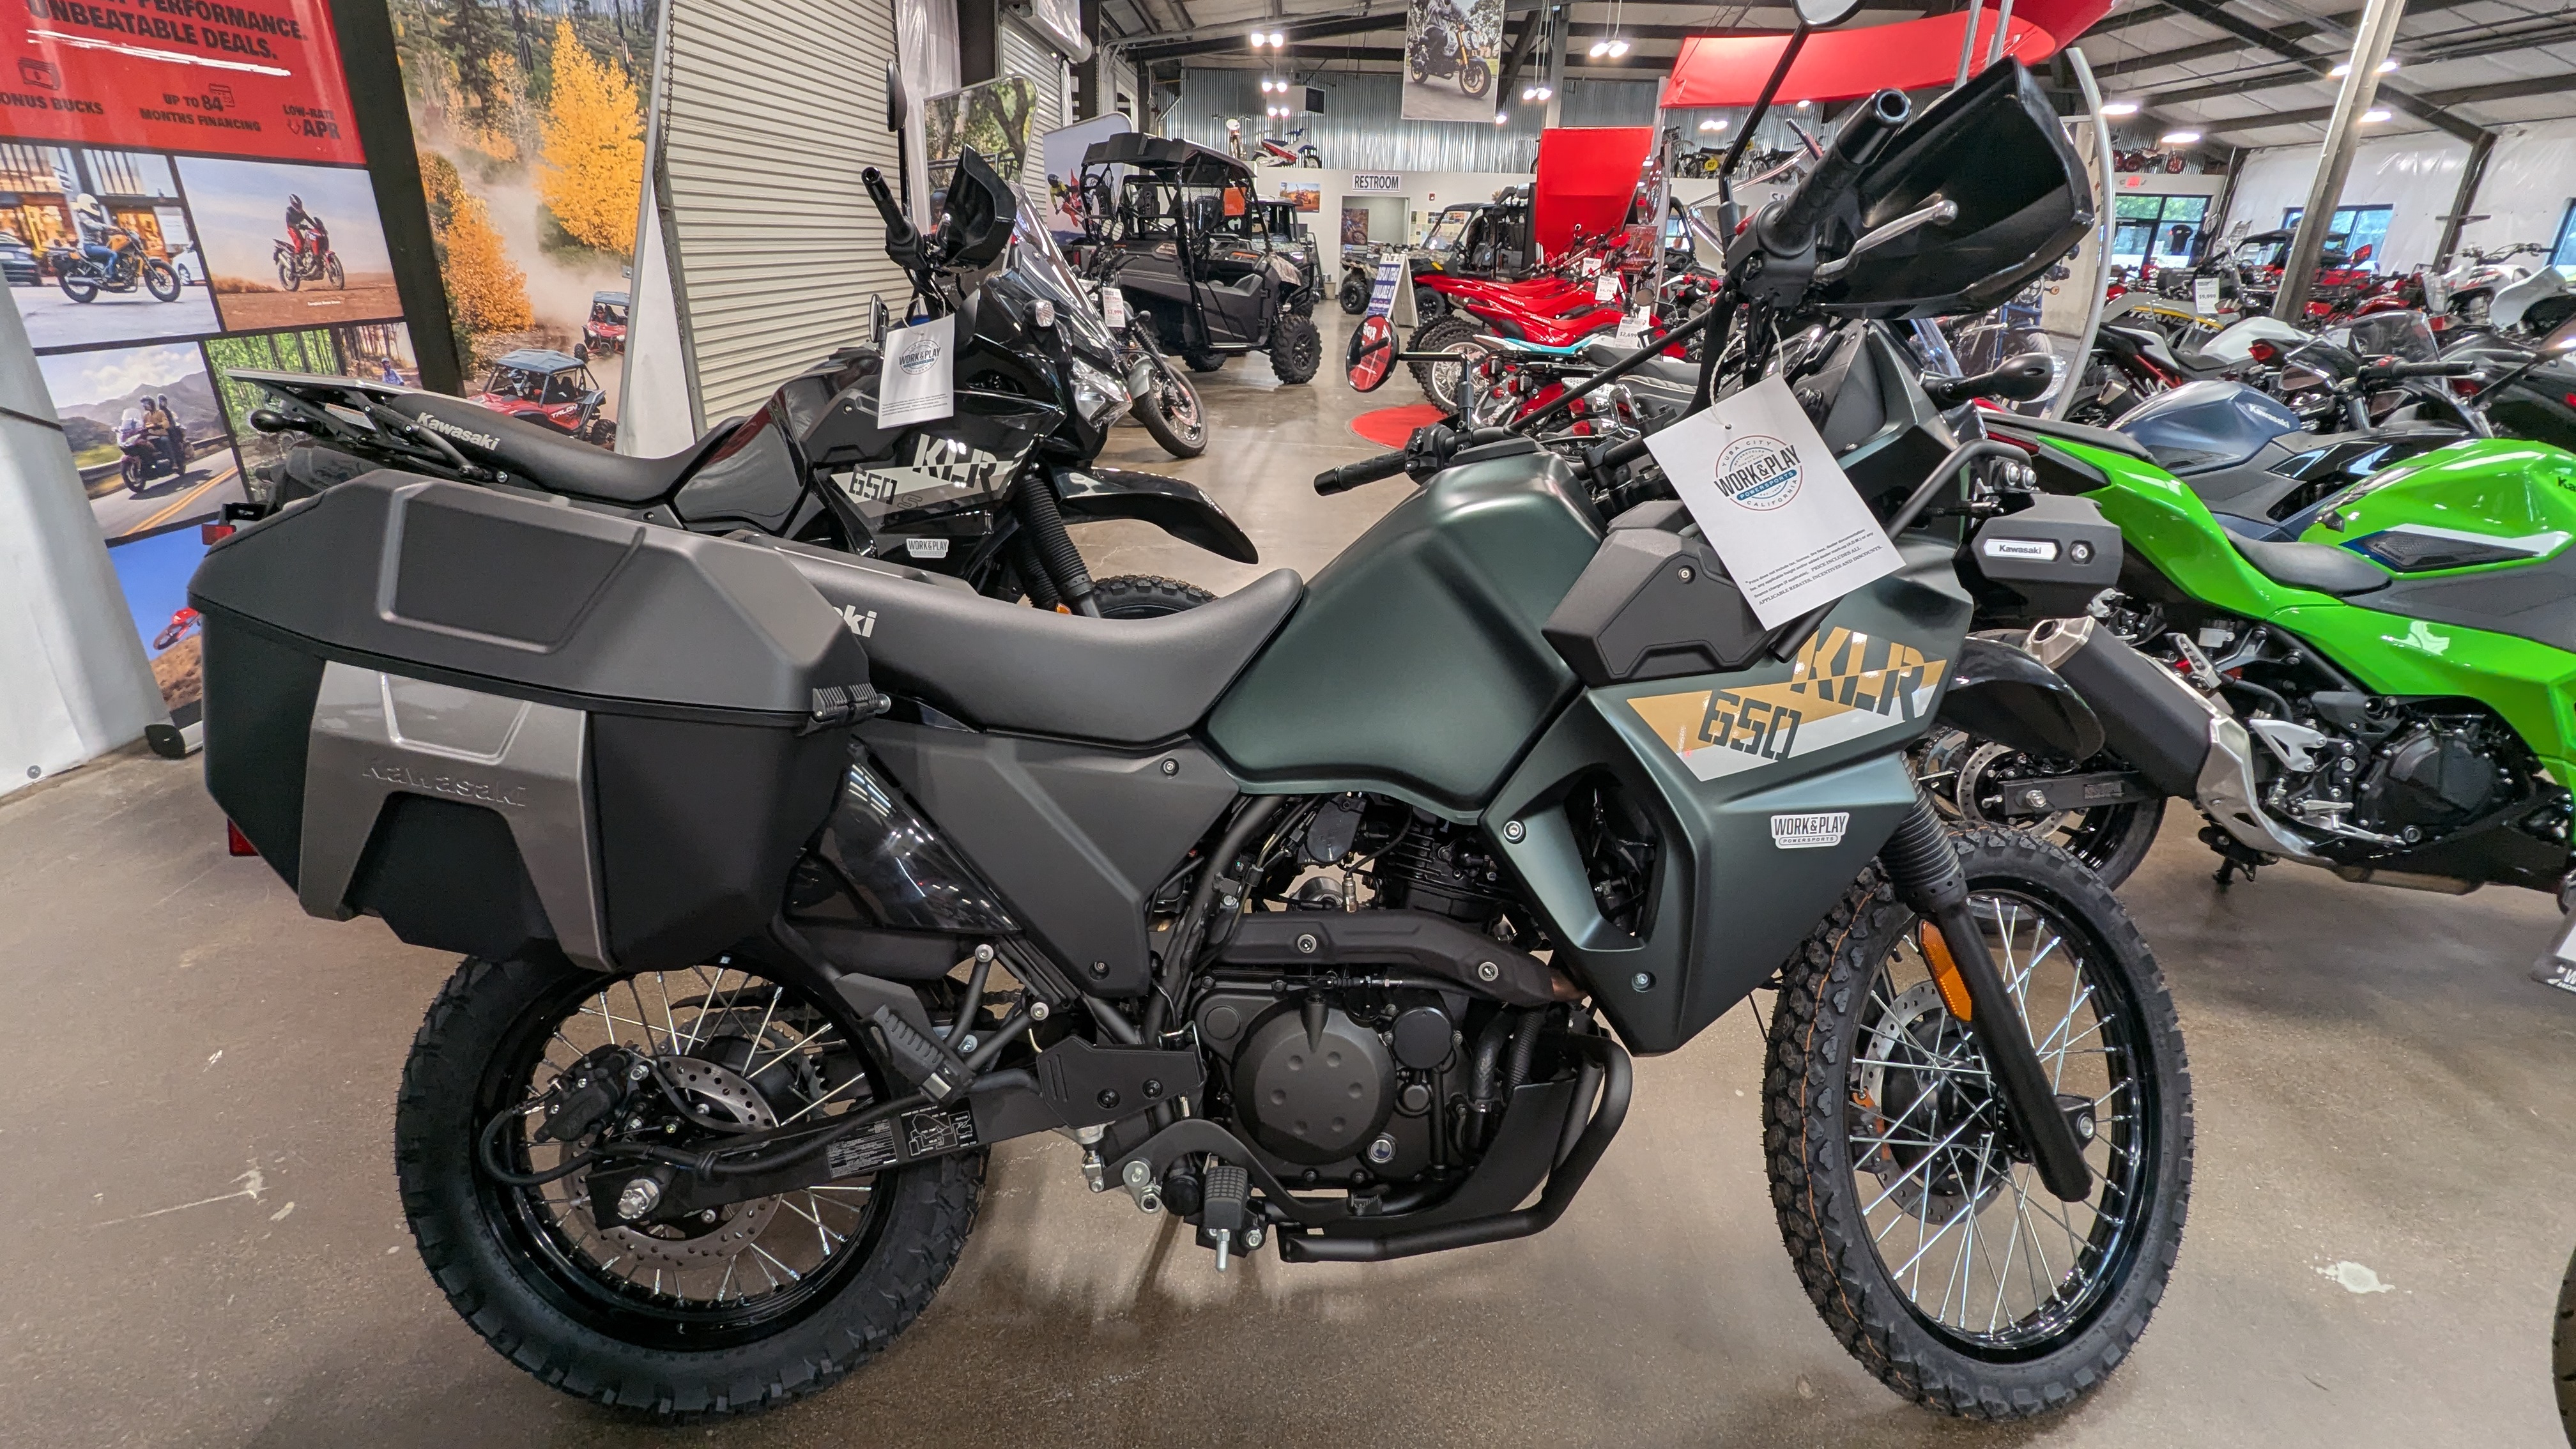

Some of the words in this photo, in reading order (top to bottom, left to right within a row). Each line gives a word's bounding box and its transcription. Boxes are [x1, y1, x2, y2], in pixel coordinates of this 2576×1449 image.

[28, 0, 198, 45] UNBEATABLE
[201, 27, 279, 60] DEALS.
[50, 96, 104, 115] BUCKS
[162, 93, 180, 105] UP
[183, 96, 199, 108] TO
[201, 95, 223, 112] 84
[139, 107, 194, 125] MONTHS
[197, 114, 261, 132] FINANCING
[303, 118, 341, 140] APR
[1354, 175, 1399, 189] RESTROOM
[1485, 281, 1510, 291] HONDA
[1499, 295, 1525, 307] HONDA
[1529, 314, 1551, 325] HONDA
[1519, 340, 1542, 351] HONDA
[551, 403, 578, 418] TALON
[417, 411, 500, 451] Kawasaki
[912, 433, 997, 493] KLR
[1722, 446, 1740, 468] YUBA
[848, 472, 898, 505] 650
[1739, 470, 1795, 499] POWERSPORTS
[1746, 479, 1797, 507] CALIFORNIA
[1811, 561, 1827, 572] PRICE
[1825, 551, 1851, 565] INCLUDES
[1851, 546, 1862, 555] ALL
[1999, 544, 2042, 555] Kawasaki
[1758, 588, 1790, 606] APPLICABLE
[1789, 578, 1813, 591] REBATES,
[1812, 564, 1843, 581] INCENTIVES
[1842, 558, 1853, 567] AND
[1852, 545, 1883, 562] DISCOUNTS.
[833, 604, 877, 638] ki
[1790, 626, 1926, 722] KLR
[1698, 689, 1802, 762] 650
